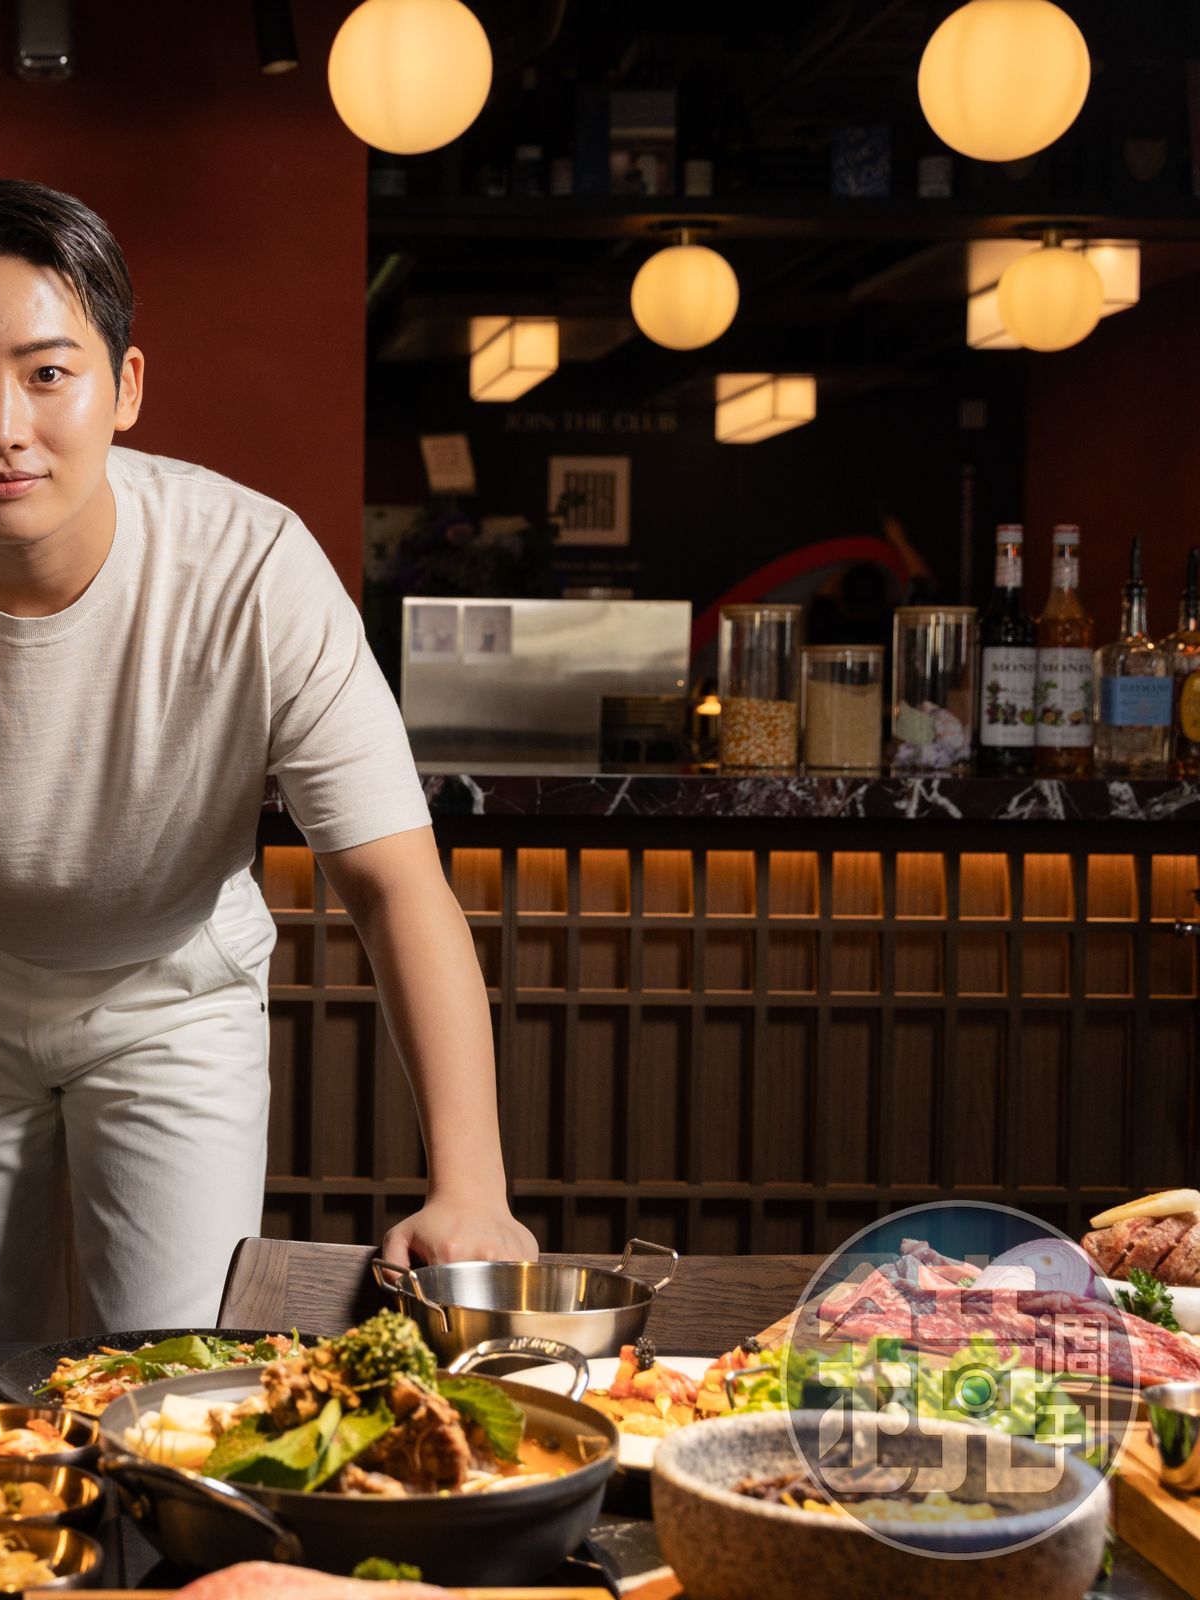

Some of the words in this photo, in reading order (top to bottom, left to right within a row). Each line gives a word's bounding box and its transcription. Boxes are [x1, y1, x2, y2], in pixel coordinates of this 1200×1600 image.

[505, 411, 555, 431] JOIN
[563, 411, 604, 431] THE
[612, 411, 677, 431] CLUB
[991, 662, 1036, 673] MONI
